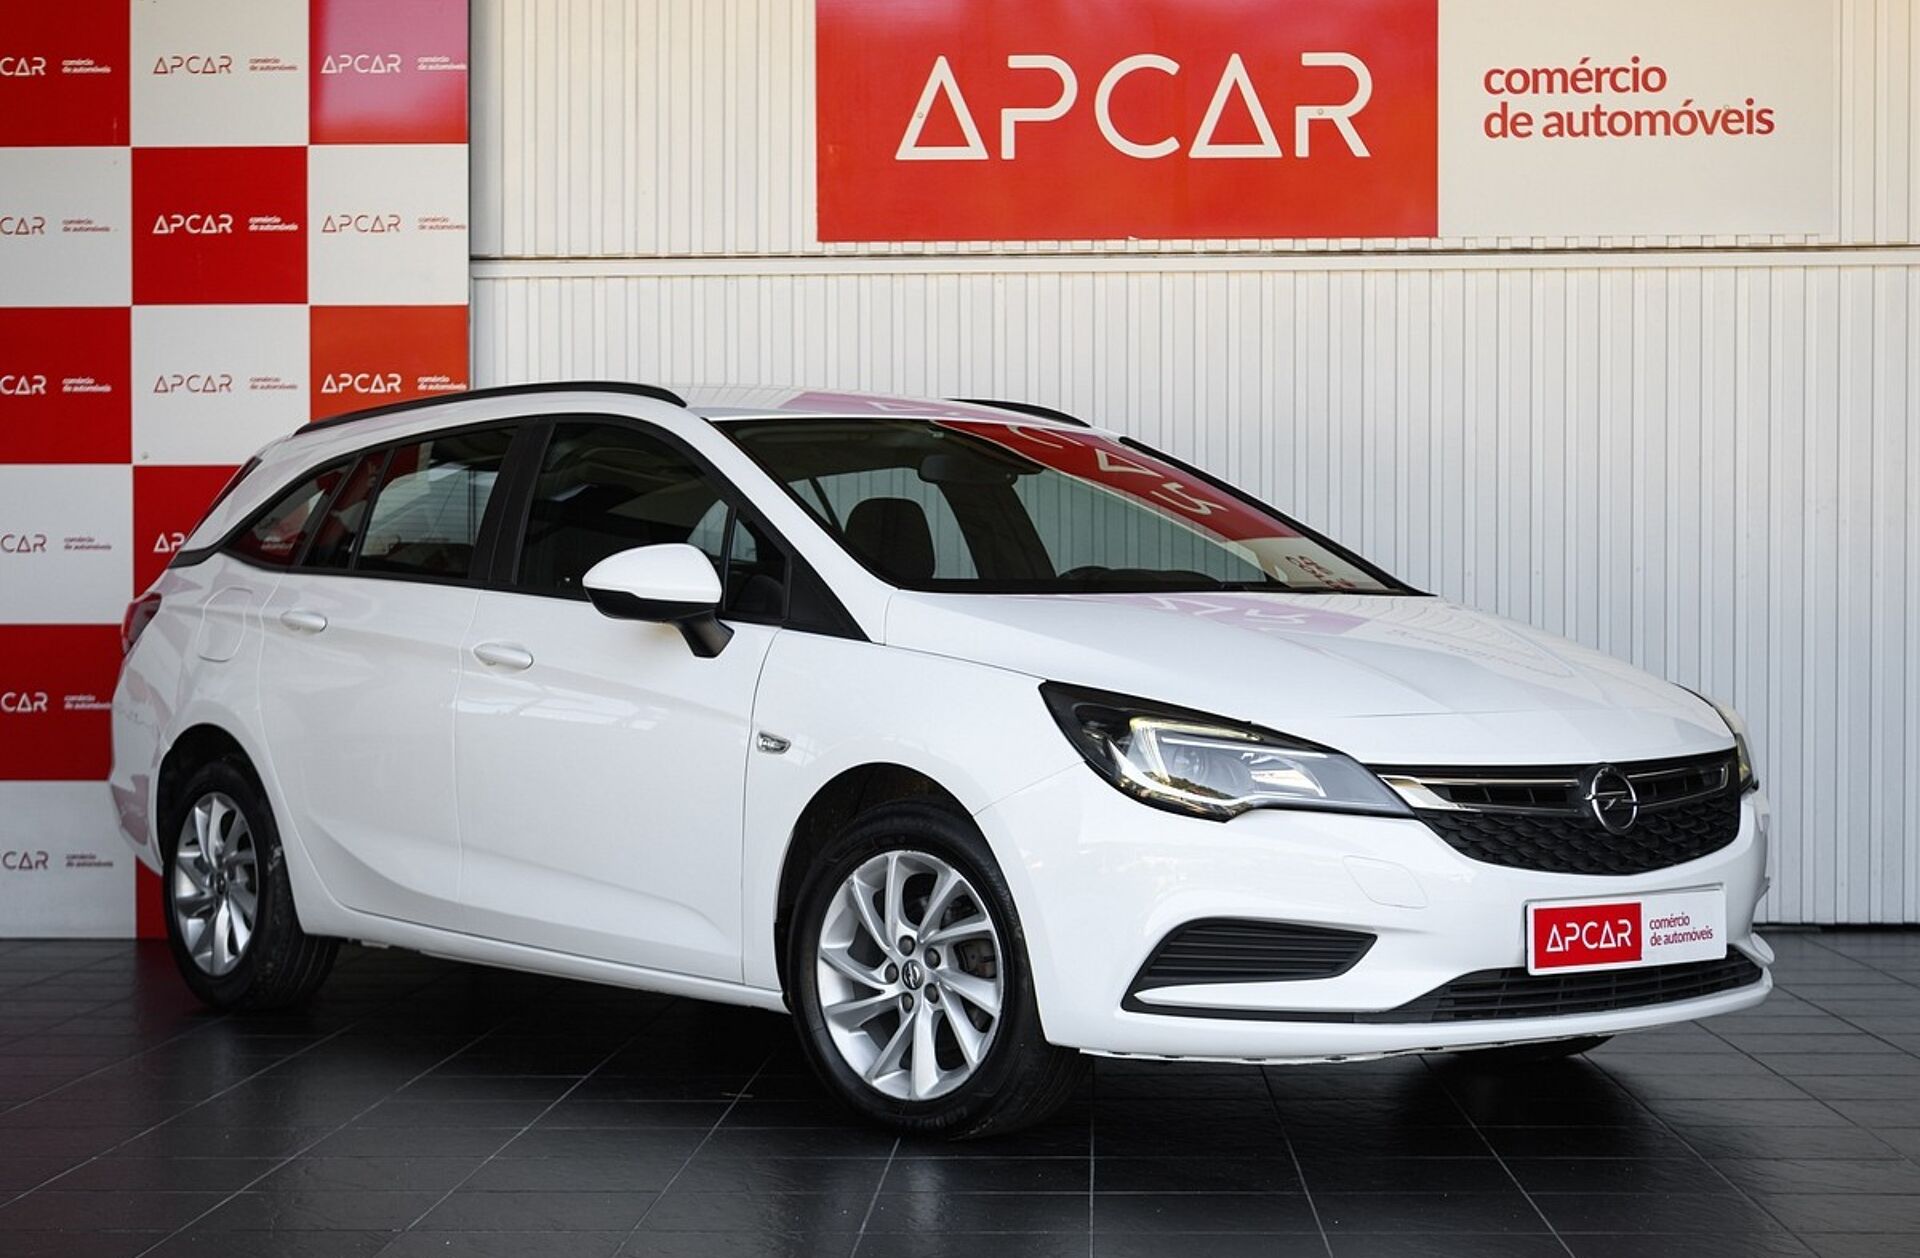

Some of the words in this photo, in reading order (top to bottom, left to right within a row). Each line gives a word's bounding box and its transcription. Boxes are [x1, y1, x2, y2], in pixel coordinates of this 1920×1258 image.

[153, 55, 232, 74] APCAR
[321, 54, 401, 74] APCAR
[1484, 56, 1667, 95] comércio
[895, 52, 1372, 160] APCAR
[1484, 101, 1534, 138] de
[1542, 98, 1775, 137] automóveis
[153, 214, 233, 234] APCAR
[322, 215, 401, 233] APCAR
[154, 374, 232, 393] APCAR
[321, 373, 401, 393] APCAR
[1650, 912, 1690, 930] comércio
[1546, 919, 1632, 952] APCAR
[1650, 932, 1663, 946] de
[1663, 925, 1713, 945] automóveis
